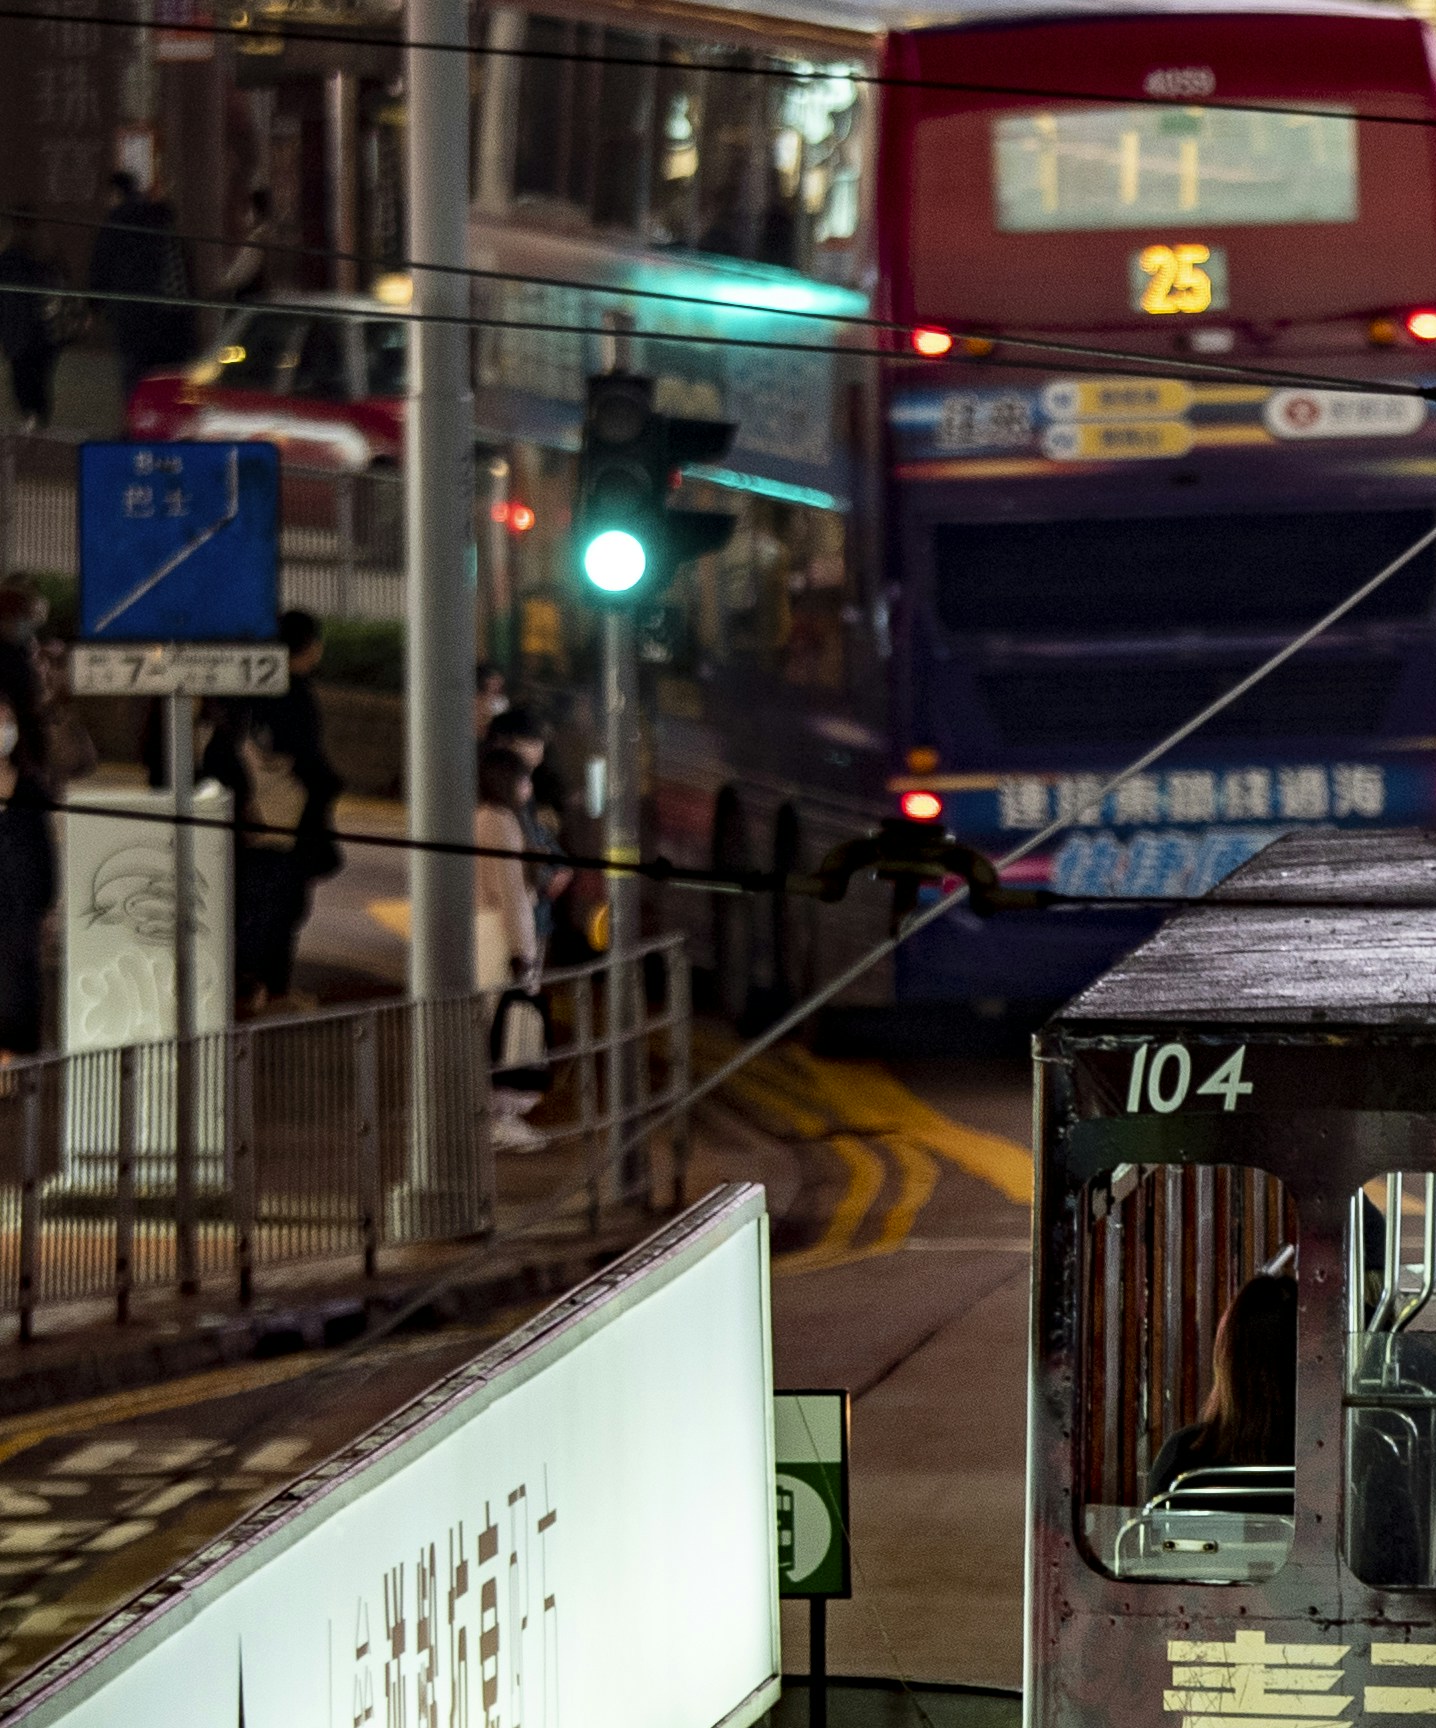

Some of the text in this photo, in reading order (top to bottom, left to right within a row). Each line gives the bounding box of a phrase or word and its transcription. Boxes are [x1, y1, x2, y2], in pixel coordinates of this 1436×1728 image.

[1139, 244, 1212, 314] 25
[240, 656, 280, 687] 12
[1126, 1042, 1253, 1114] 104
